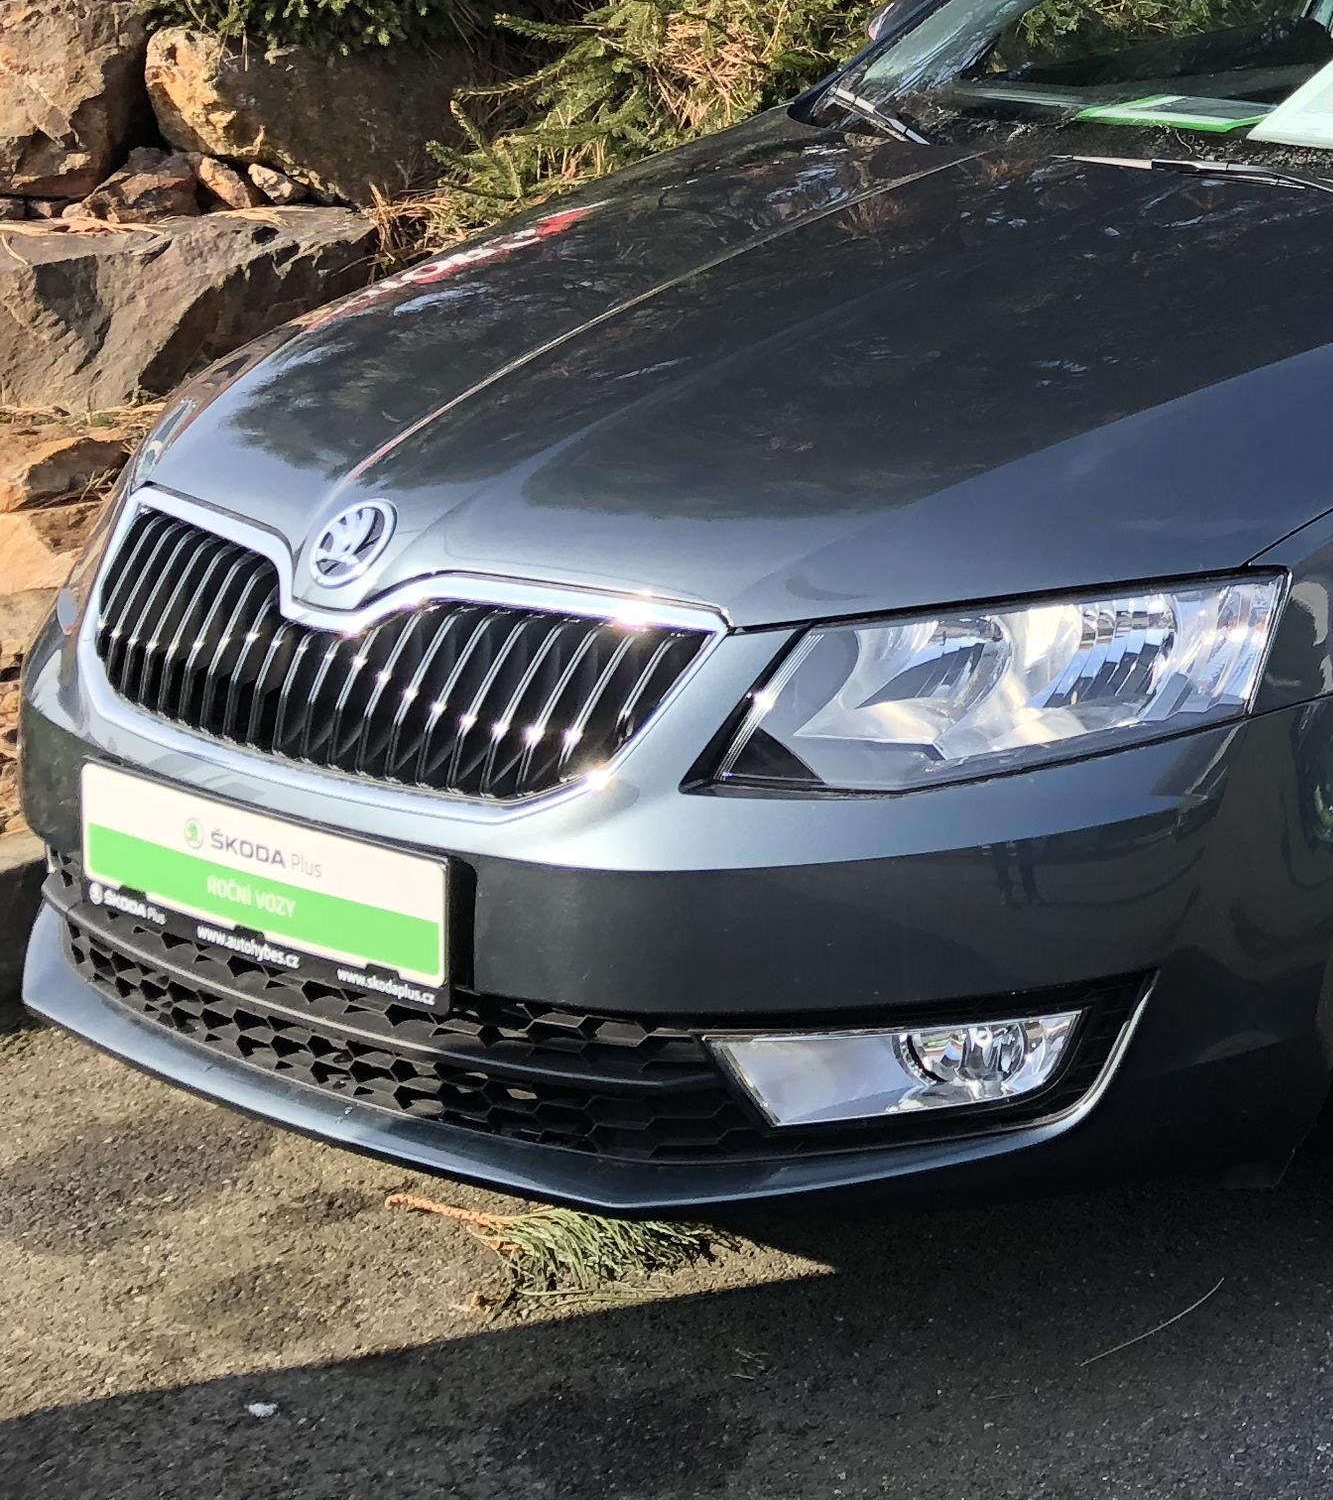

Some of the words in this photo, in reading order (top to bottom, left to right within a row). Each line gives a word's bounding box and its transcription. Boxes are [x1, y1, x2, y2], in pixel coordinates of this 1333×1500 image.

[210, 828, 287, 869] ŠKODA
[290, 852, 323, 878] Plus
[147, 907, 168, 926] Plus
[206, 874, 253, 907] ROČNÍ
[254, 888, 297, 919] VOZY
[196, 925, 300, 970] www.autohybes.cz
[336, 968, 436, 1006] www.skodaplus.cz
